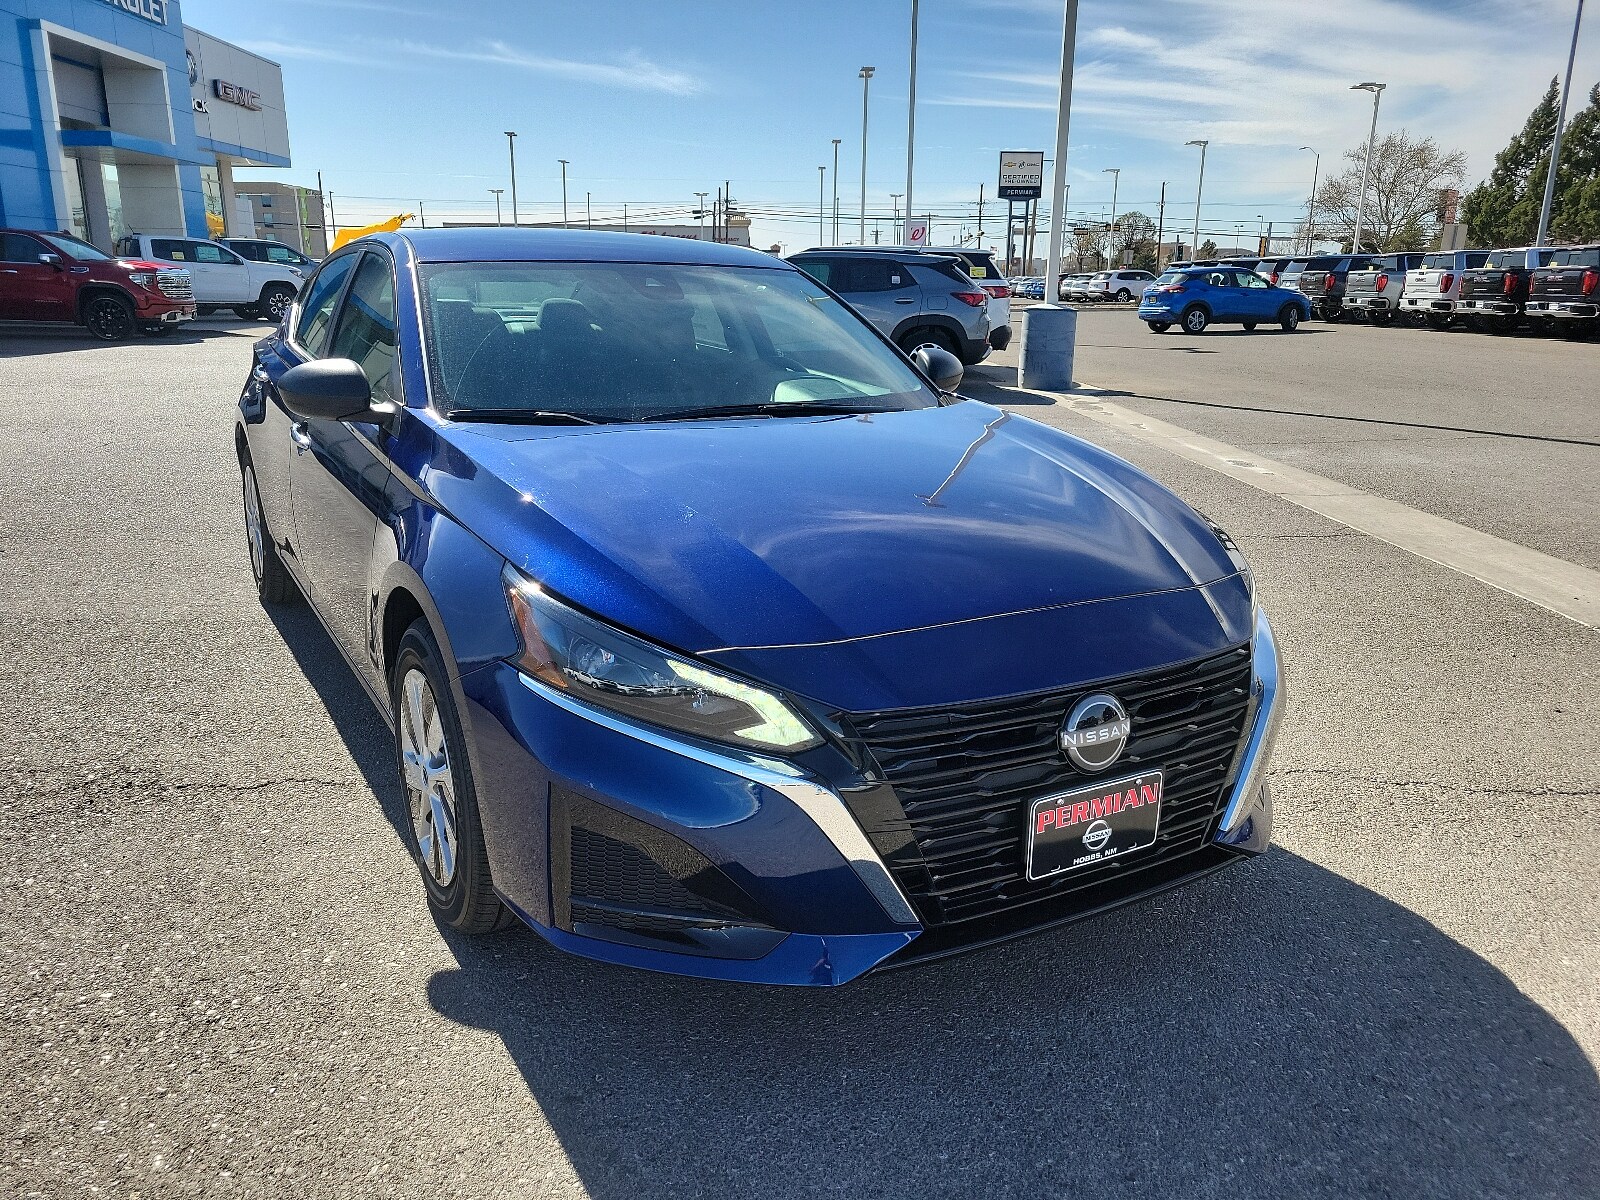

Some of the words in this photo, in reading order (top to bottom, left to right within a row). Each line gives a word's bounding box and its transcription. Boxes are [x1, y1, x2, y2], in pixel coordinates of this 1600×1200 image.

[216, 79, 263, 112] GMC
[1063, 721, 1131, 747] NISSAN
[1036, 782, 1159, 834] PERMIAN
[1085, 829, 1110, 842] NISSAN
[1072, 852, 1103, 866] HOBBS,
[1104, 847, 1118, 857] NM
